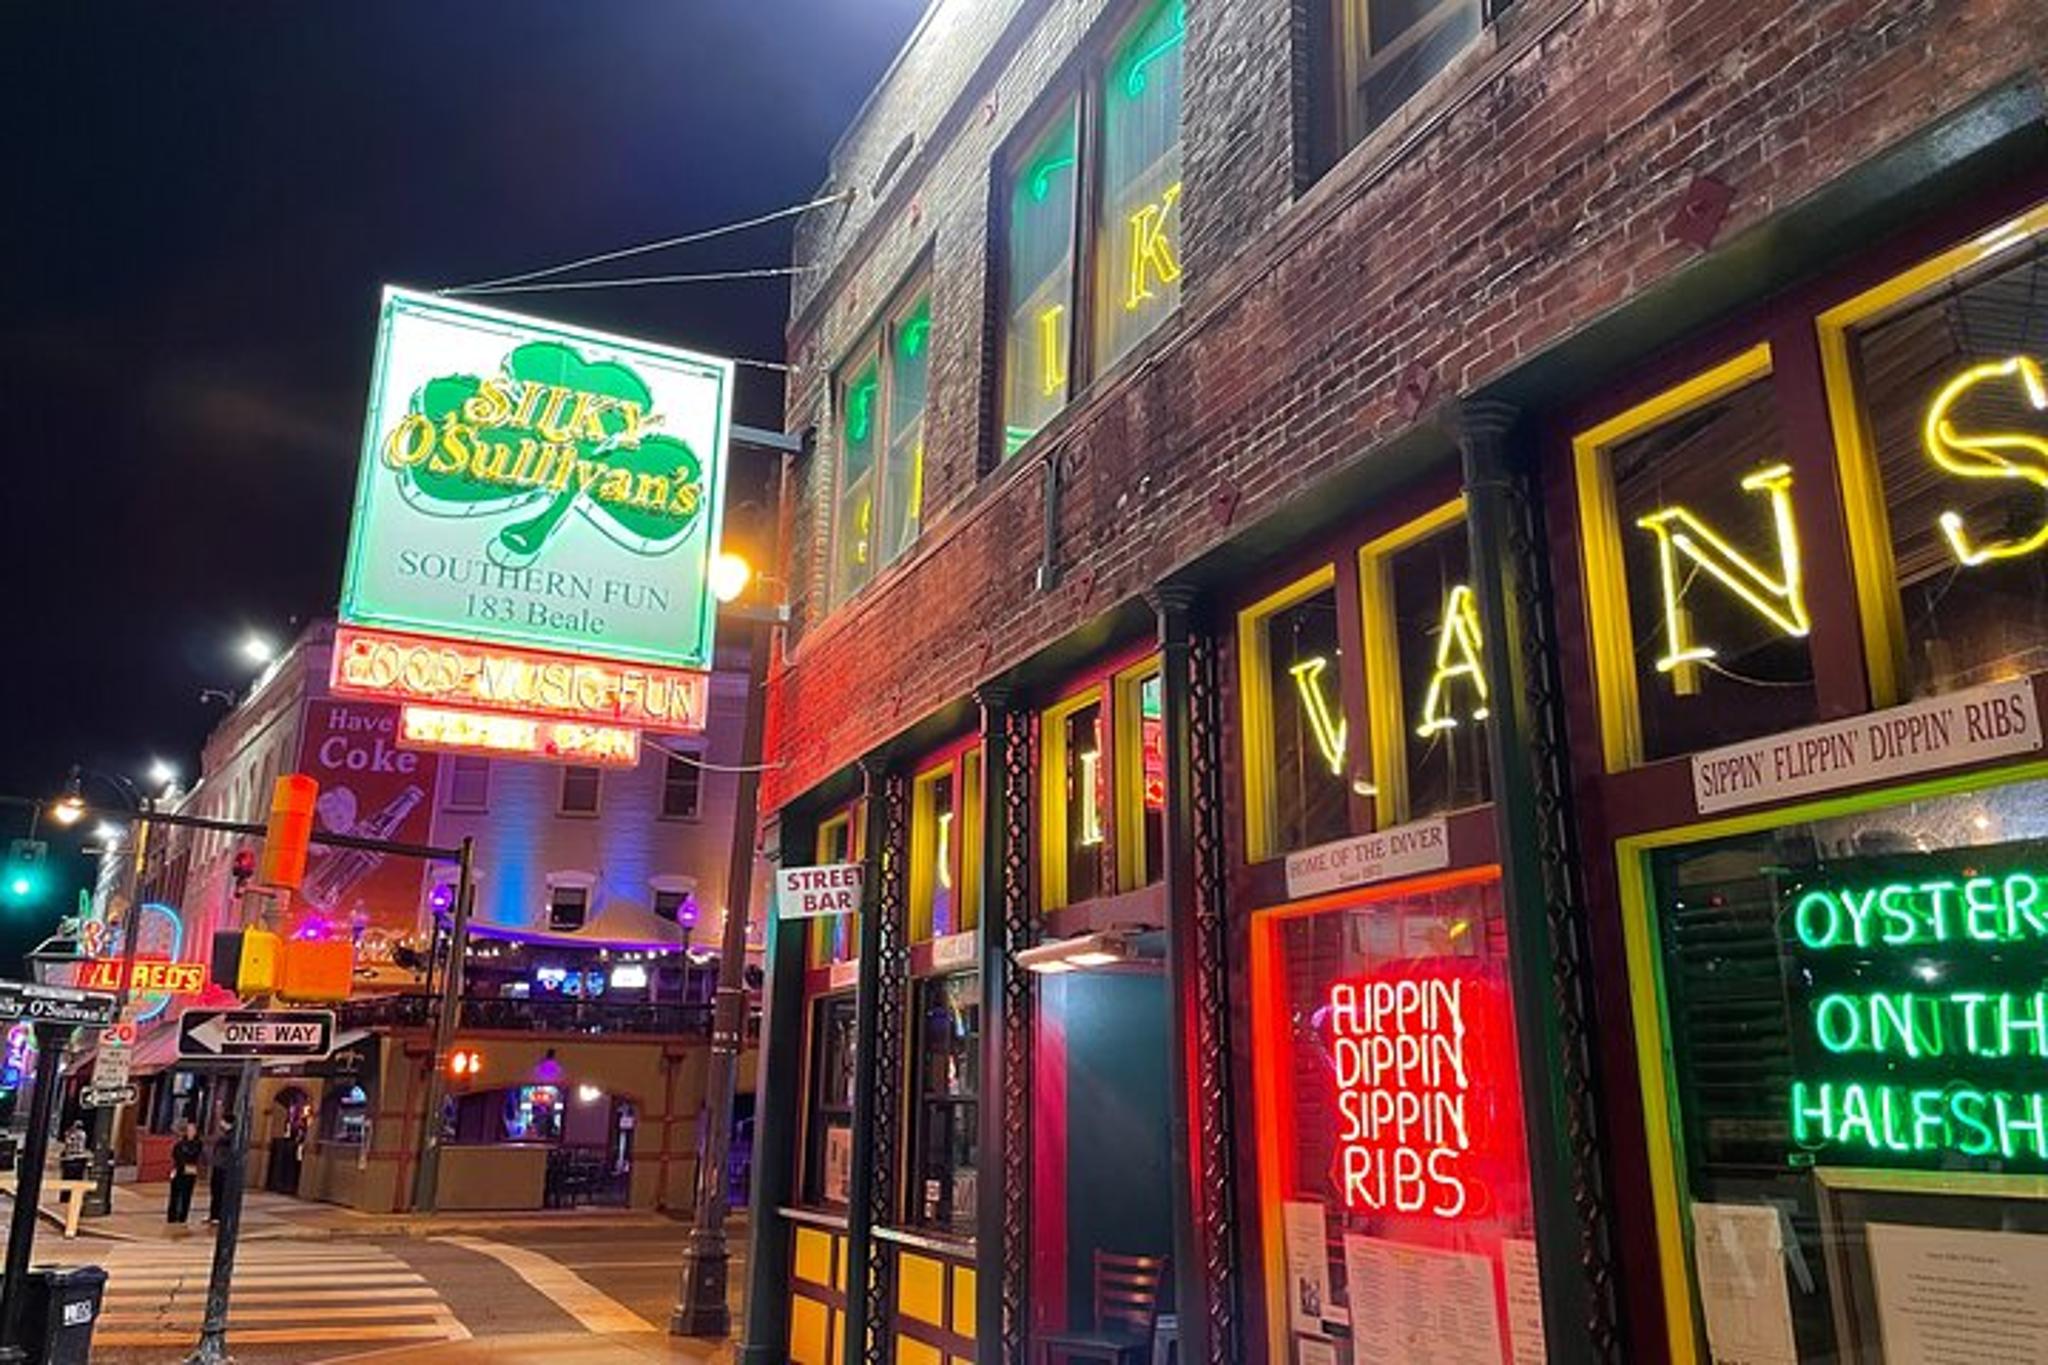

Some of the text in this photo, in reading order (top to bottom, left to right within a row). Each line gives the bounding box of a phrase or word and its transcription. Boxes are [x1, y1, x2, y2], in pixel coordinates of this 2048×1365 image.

[1125, 181, 1181, 310] K
[463, 376, 664, 449] SILKY
[384, 411, 699, 515] O'Sullivan's
[1416, 585, 1488, 737] A
[1637, 464, 1810, 671] N
[1925, 356, 2048, 566] S
[398, 551, 670, 611] SOUTHERN FUN
[466, 593, 604, 633] 183 Beale
[329, 708, 392, 732] Have
[1701, 694, 2027, 797] SIPPIN' FLIPPIN' DIPPIN' RIBS
[319, 736, 417, 773] Coke
[787, 867, 862, 891] STREET
[1289, 827, 1443, 879] HOME OF THE DIVER
[804, 891, 851, 912] BAR
[1795, 873, 2048, 948] OYSTER
[226, 1025, 316, 1042] ONE WAY
[1330, 978, 1466, 1038] FLIPPIN
[1817, 991, 1919, 1058] ON
[1336, 1034, 1469, 1089] DIPPIN
[1339, 1089, 1469, 1149] SIPPIN
[1344, 1145, 1466, 1218] RIBS
